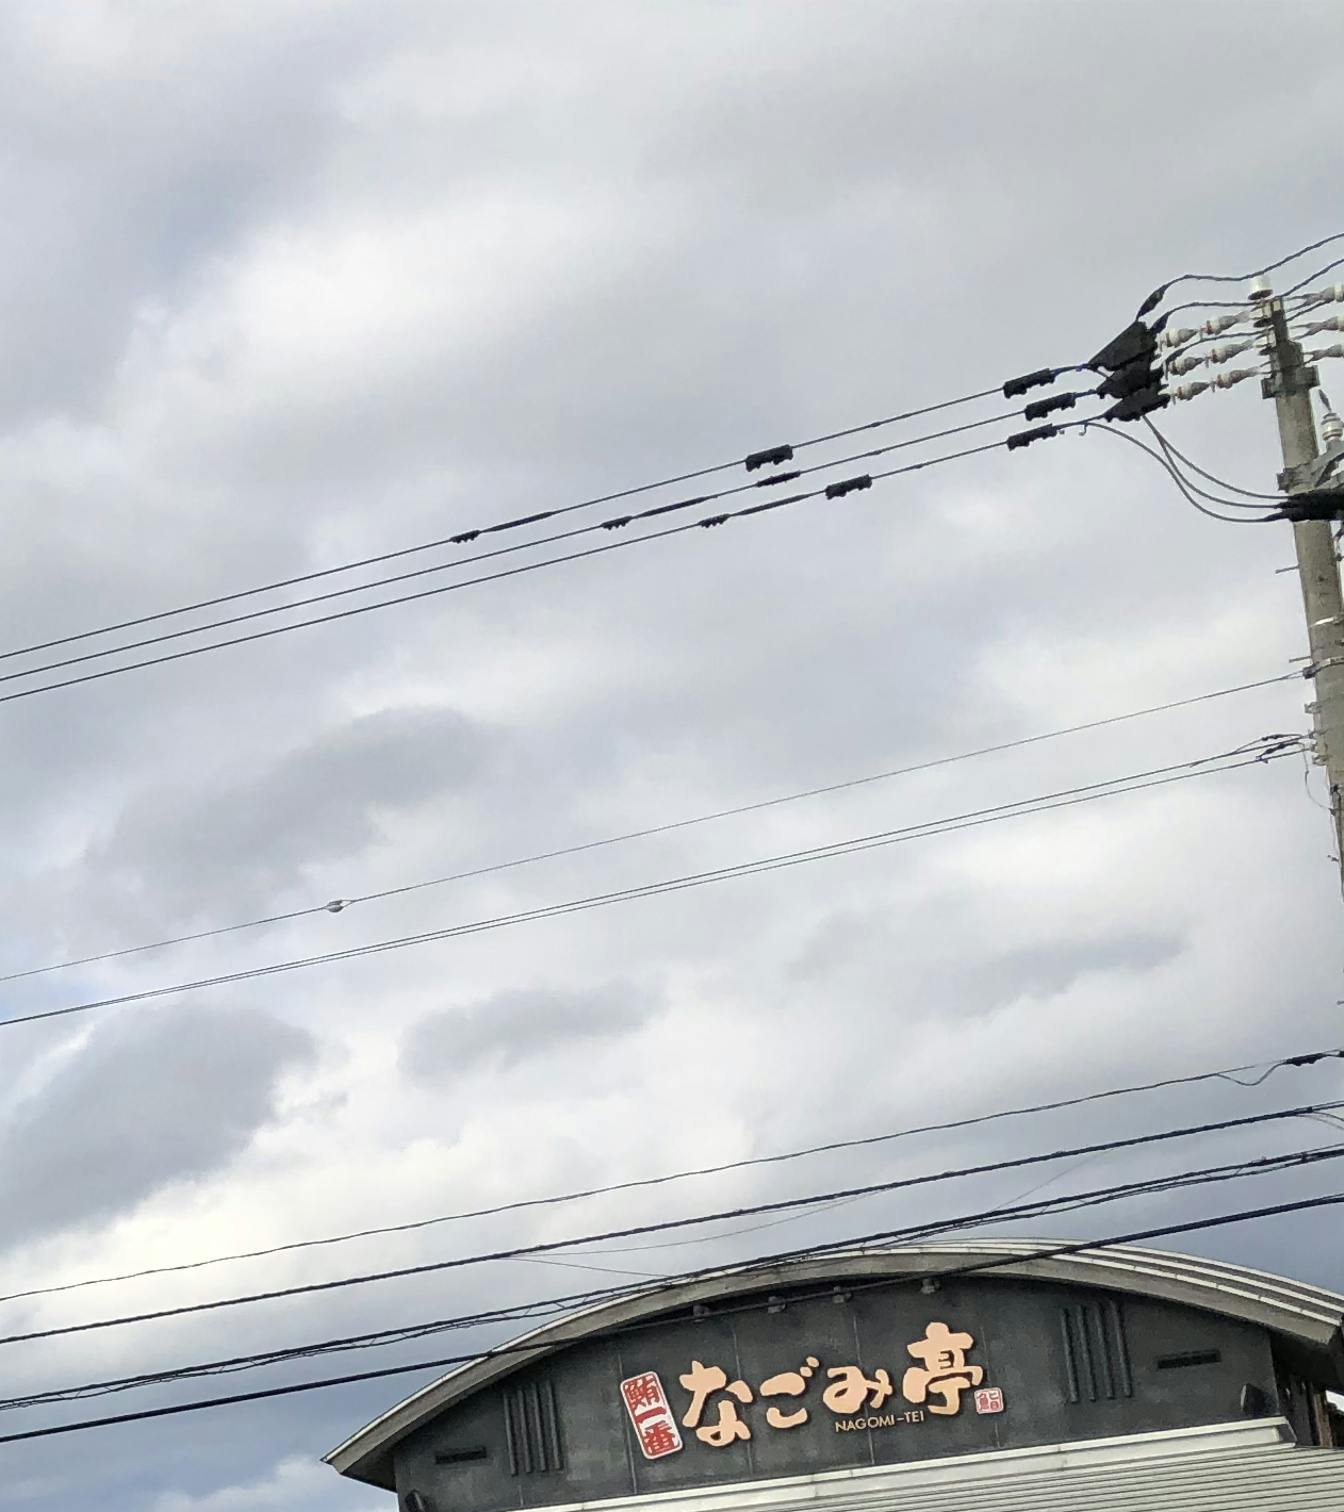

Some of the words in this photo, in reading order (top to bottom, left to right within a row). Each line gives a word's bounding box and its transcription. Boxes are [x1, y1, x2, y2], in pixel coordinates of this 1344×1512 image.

[678, 1321, 984, 1447] なごみ亭
[834, 1410, 925, 1433] NAGOMI-TEI
